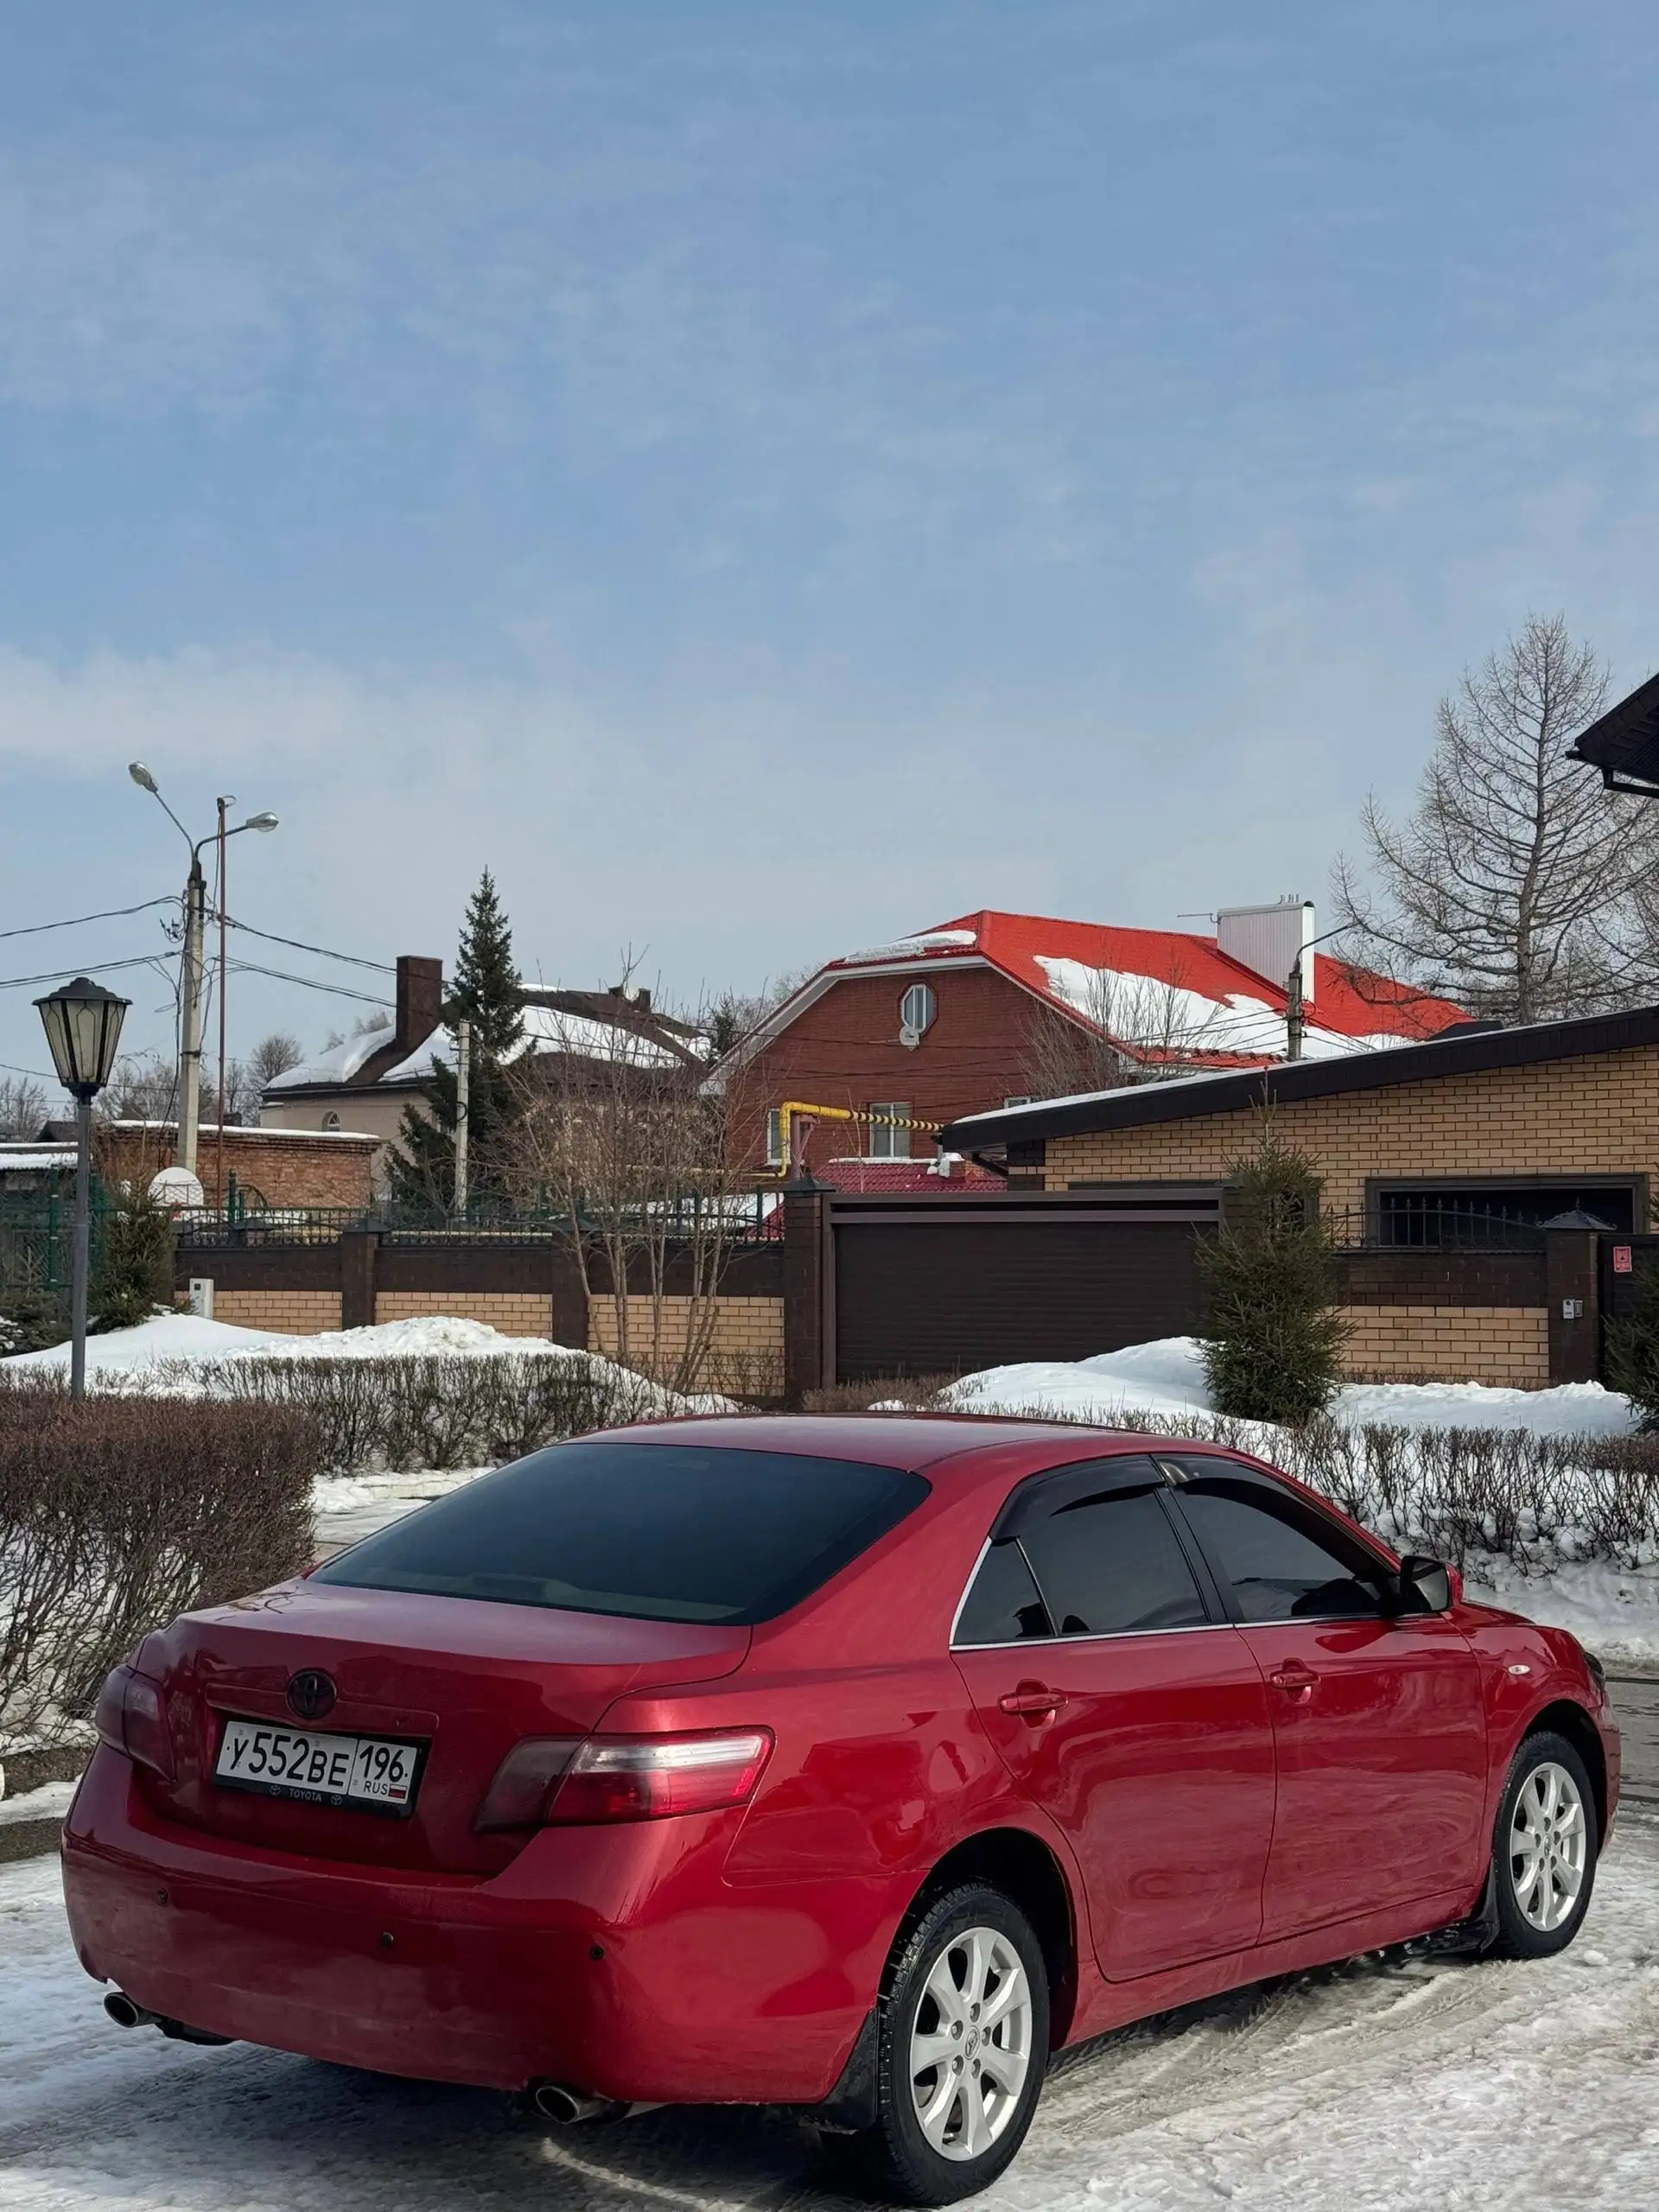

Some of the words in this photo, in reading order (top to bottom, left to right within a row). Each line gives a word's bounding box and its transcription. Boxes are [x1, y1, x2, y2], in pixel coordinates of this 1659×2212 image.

[359, 1745, 404, 1783] 196
[289, 1787, 322, 1802] TOYOTA
[363, 1780, 388, 1796] RUS
